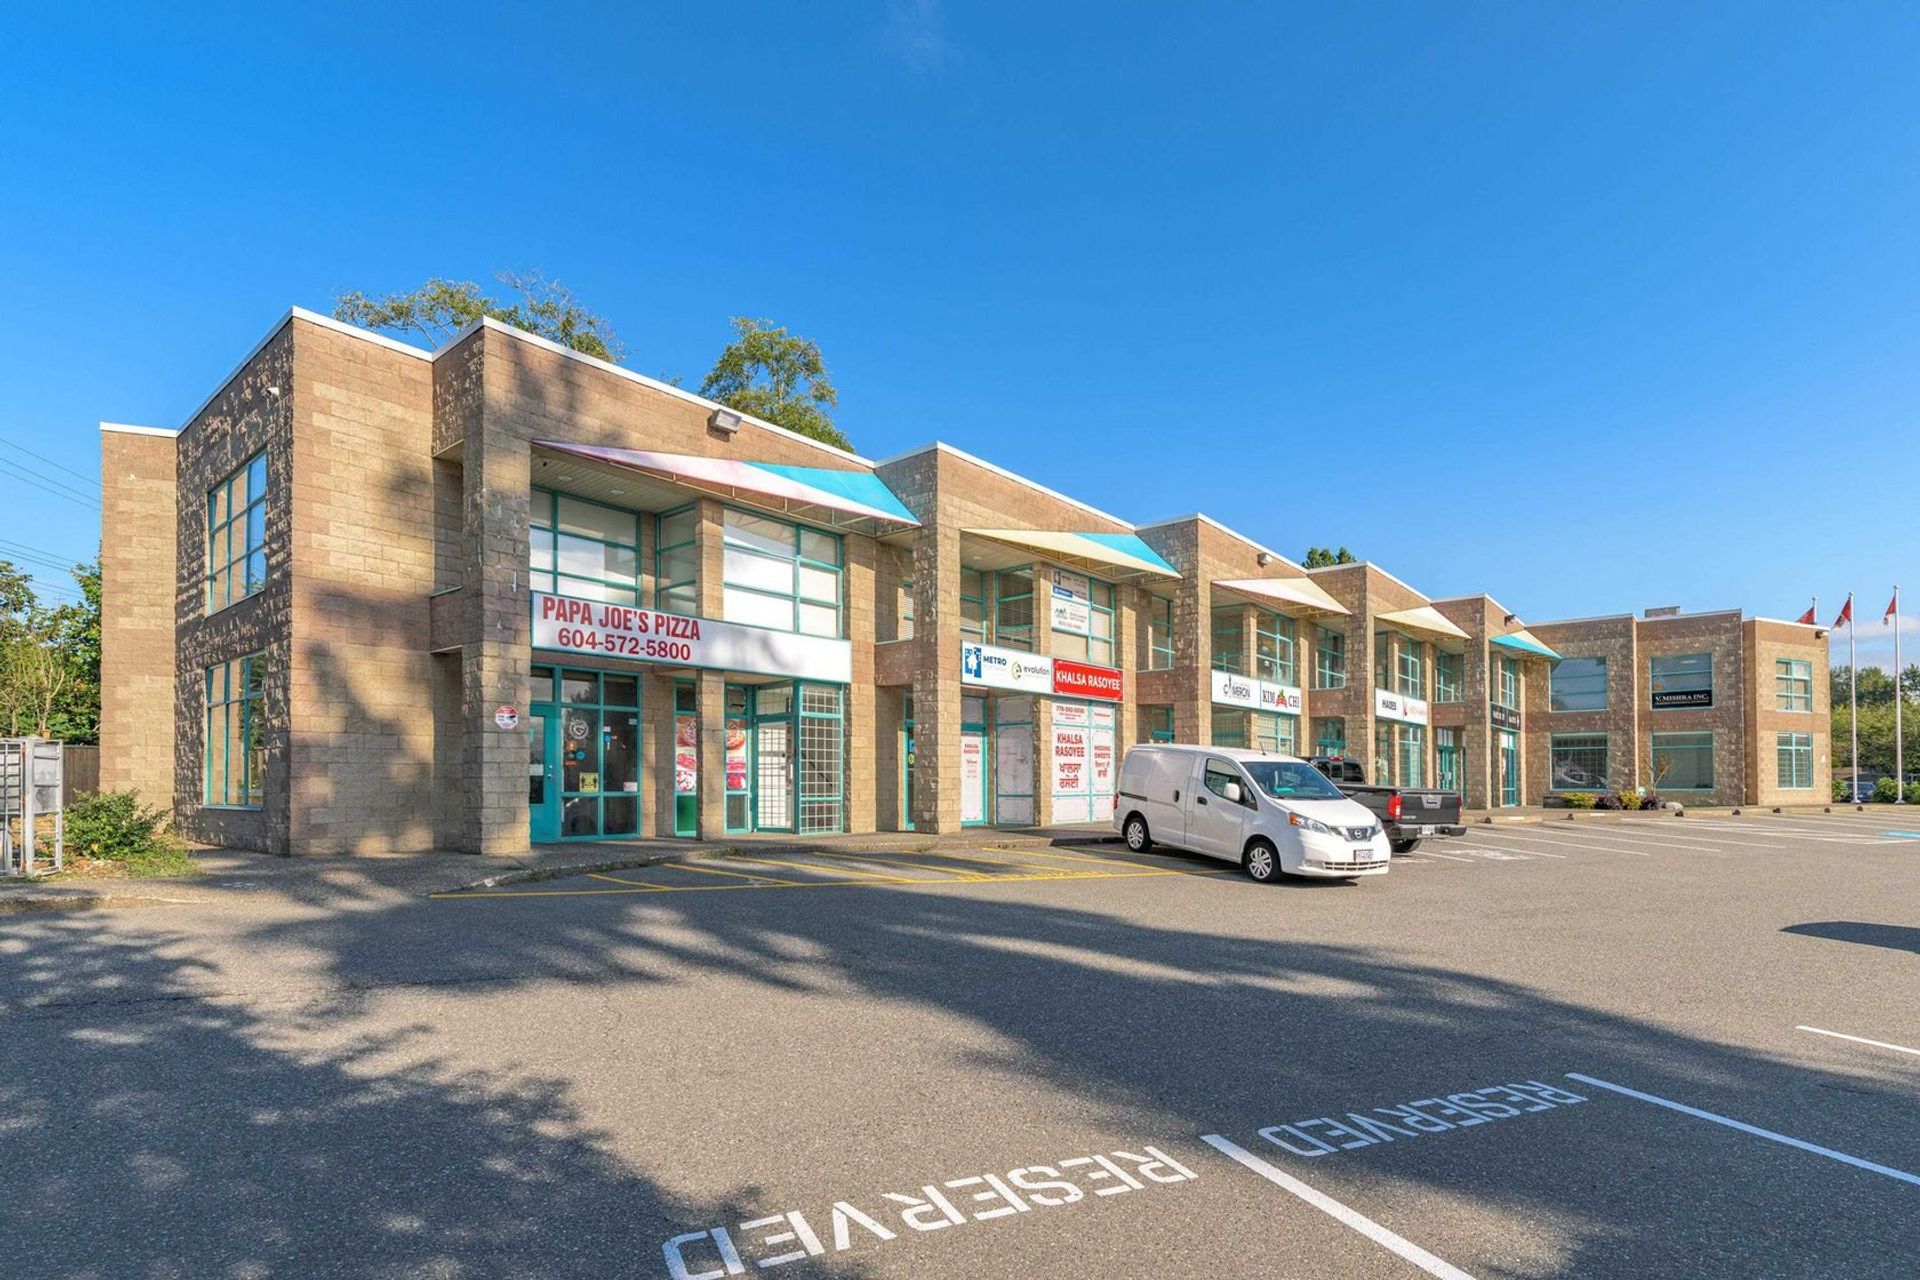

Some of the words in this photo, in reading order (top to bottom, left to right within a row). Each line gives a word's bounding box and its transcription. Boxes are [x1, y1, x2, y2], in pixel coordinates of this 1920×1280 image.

[542, 596, 592, 626] PAPA
[599, 606, 649, 634] JOE'S
[655, 614, 701, 640] PIZZA
[558, 628, 691, 661] 604-572-5800
[983, 656, 1007, 666] METRO
[1023, 665, 1050, 675] evolution
[1056, 670, 1087, 686] KHALSA
[1088, 675, 1121, 691] RASOYEE
[1057, 733, 1084, 745] KHALSA
[1055, 746, 1085, 757] RASOYEE
[1258, 1080, 1588, 1157] RESERVED
[661, 1145, 1199, 1280] RESERVED
